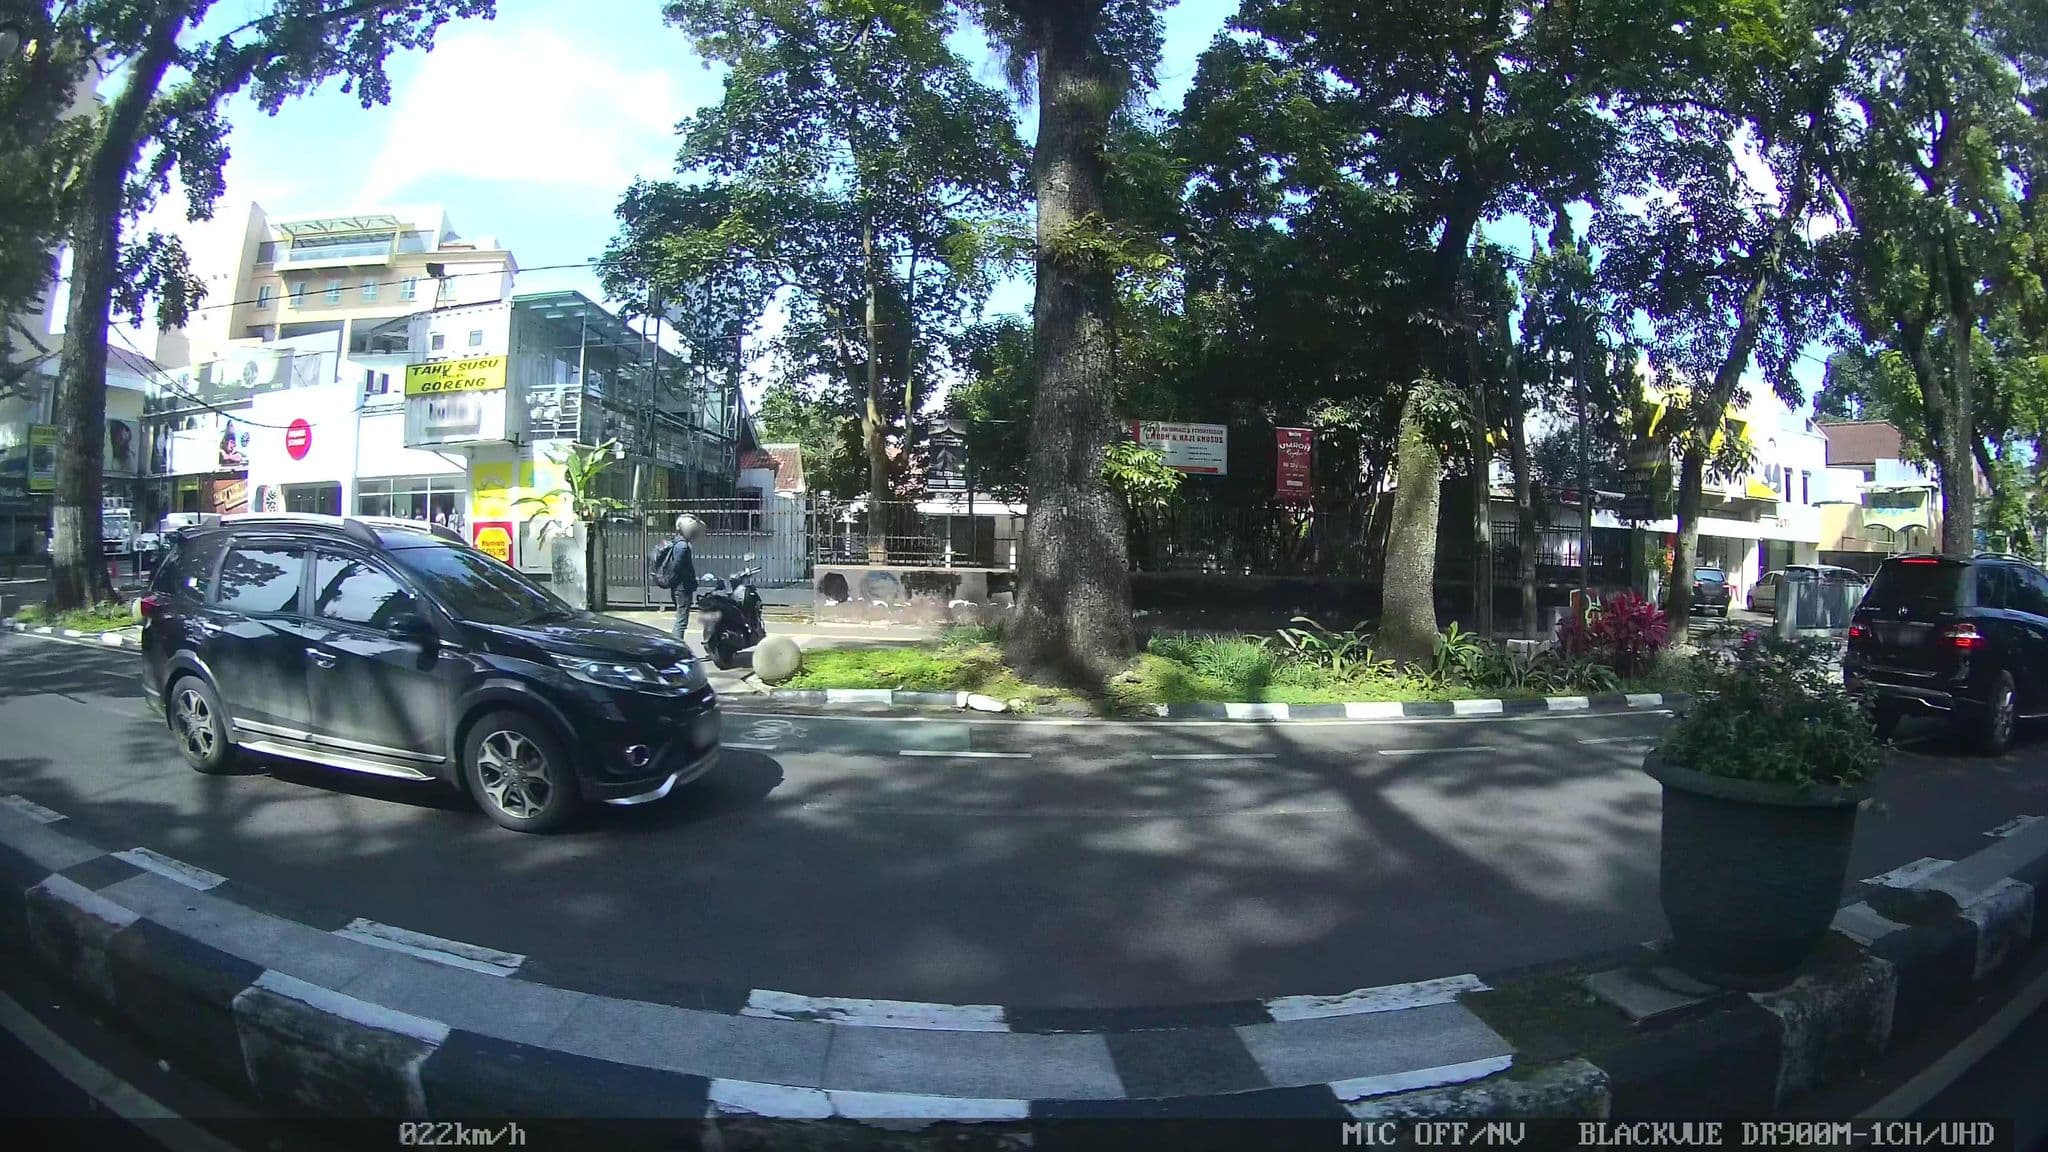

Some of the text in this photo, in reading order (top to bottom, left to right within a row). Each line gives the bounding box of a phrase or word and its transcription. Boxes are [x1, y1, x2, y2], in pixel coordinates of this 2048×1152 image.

[413, 364, 452, 376] TAHU
[459, 359, 498, 371] SUSU
[421, 378, 486, 392] GORENG
[1279, 442, 1311, 452] UMROH
